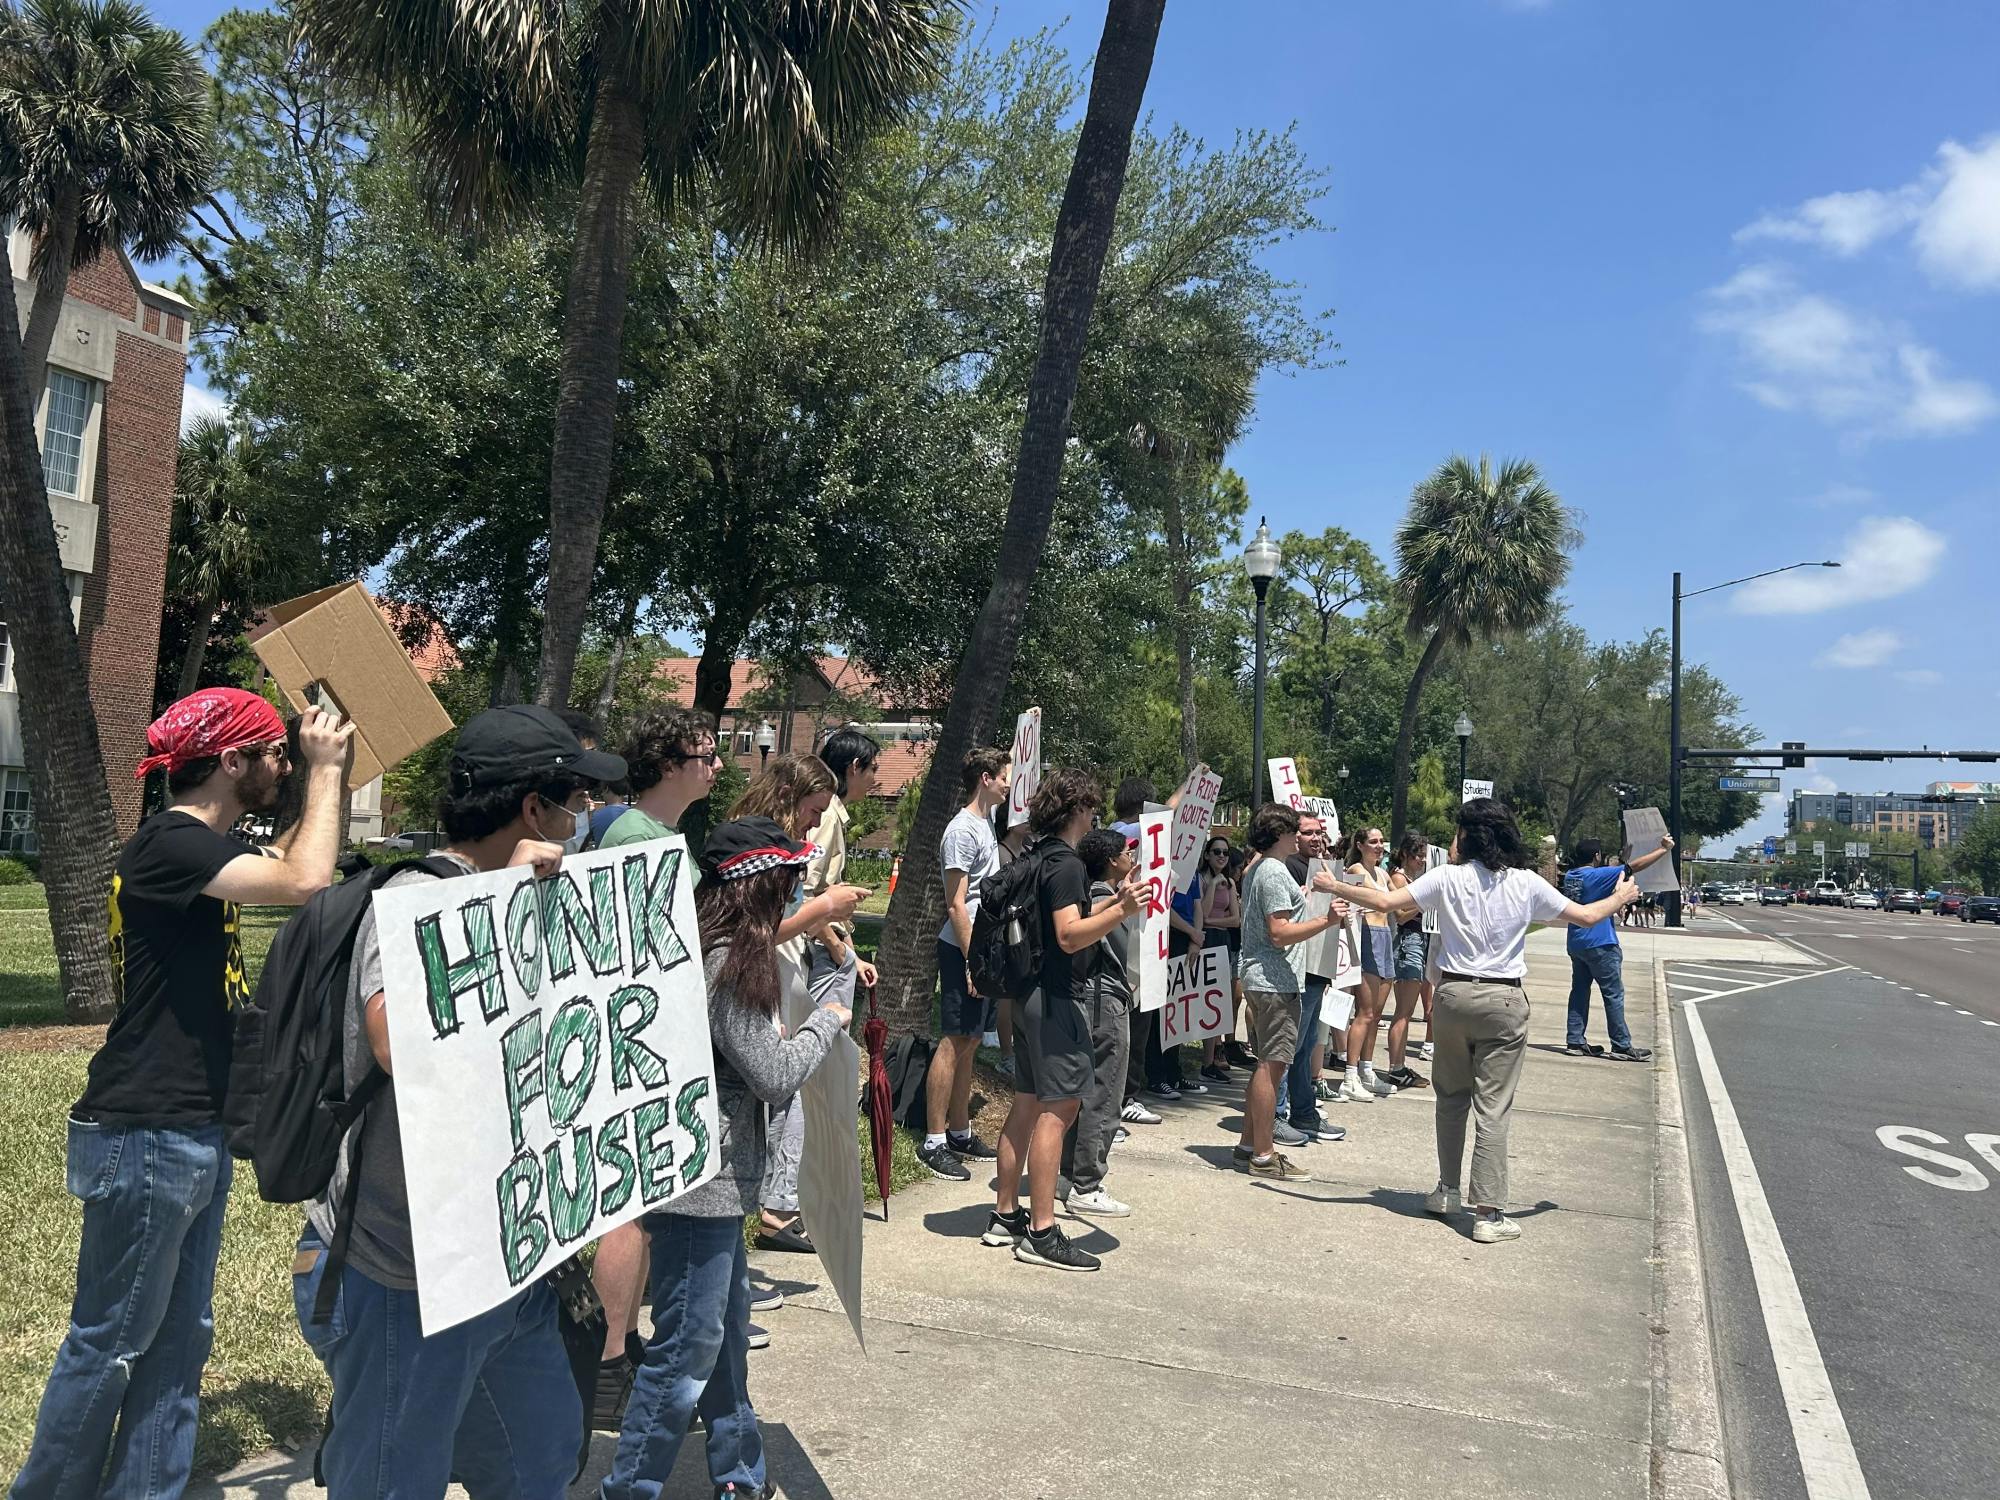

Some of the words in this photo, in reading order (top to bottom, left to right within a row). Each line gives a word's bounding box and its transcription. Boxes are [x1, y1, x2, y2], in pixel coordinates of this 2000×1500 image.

[1014, 724, 1034, 766] NO
[1279, 765, 1295, 785] I
[1727, 780, 1754, 789] Union
[1758, 780, 1772, 789] Rd
[1185, 776, 1196, 795] I
[1196, 777, 1219, 803] RIDE
[1464, 781, 1491, 797] Students
[1180, 804, 1209, 830] ROUTE
[1304, 798, 1320, 817] NO
[1319, 799, 1335, 818] RTS
[1147, 823, 1165, 870] I
[1172, 833, 1196, 860] 17
[415, 848, 691, 1040] HONK
[1164, 989, 1224, 1041] RTS
[499, 984, 669, 1153] FOR
[497, 1076, 710, 1287] BUSES
